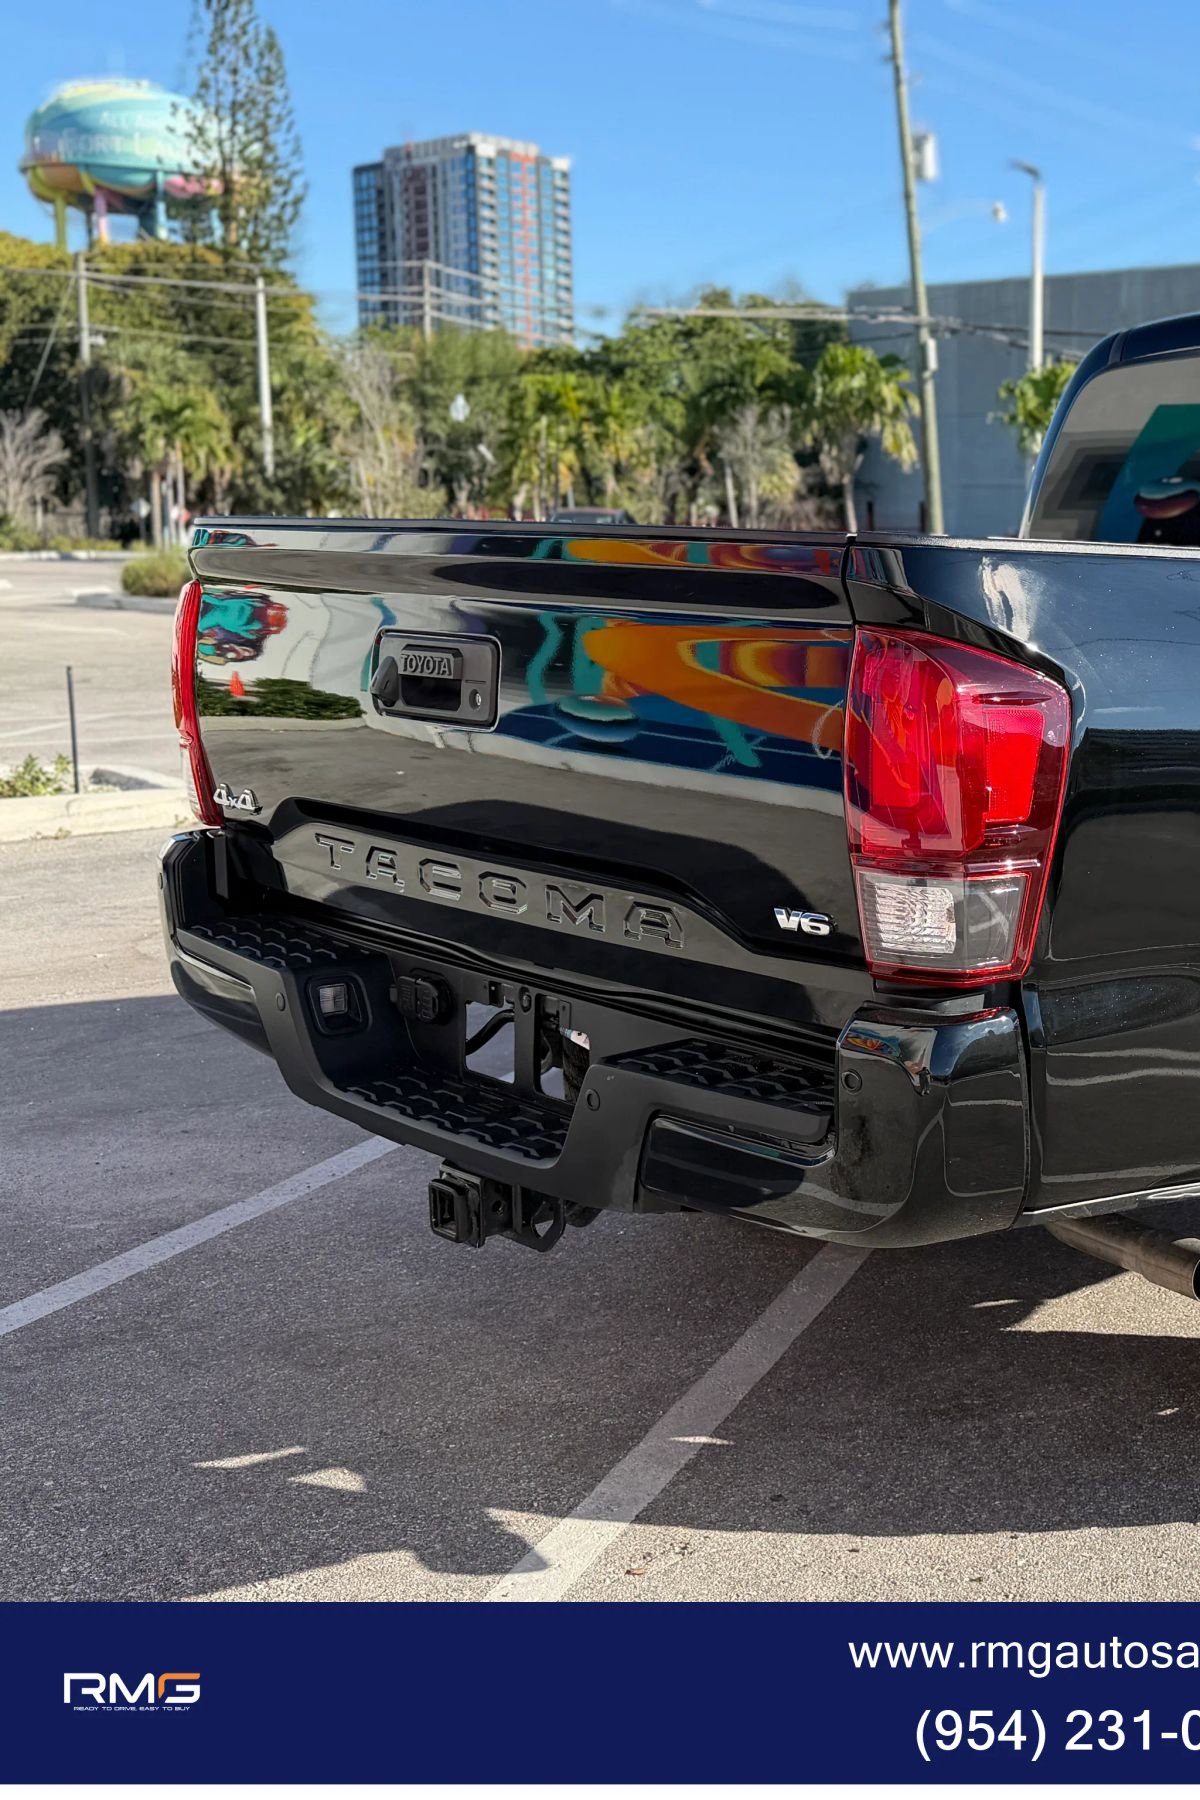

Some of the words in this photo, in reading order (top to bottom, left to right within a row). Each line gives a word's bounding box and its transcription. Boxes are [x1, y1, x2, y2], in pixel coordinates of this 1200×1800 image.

[401, 653, 453, 677] TOYOTA
[314, 832, 689, 951] TACOMA
[773, 906, 834, 936] V6
